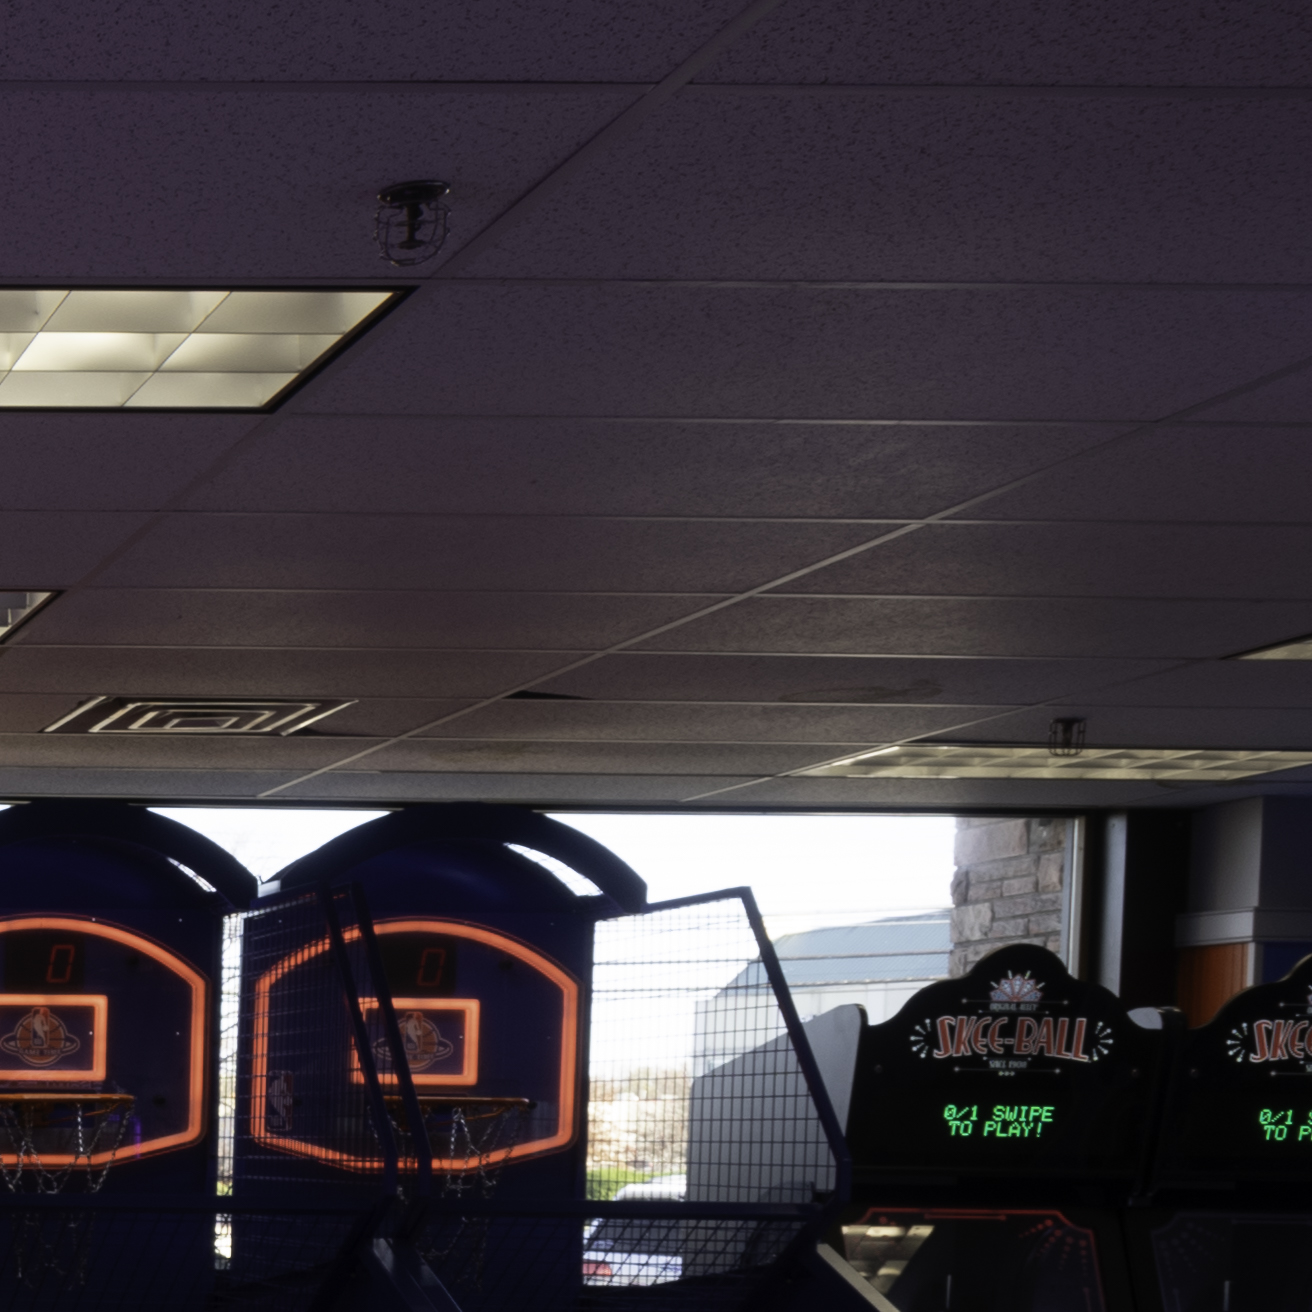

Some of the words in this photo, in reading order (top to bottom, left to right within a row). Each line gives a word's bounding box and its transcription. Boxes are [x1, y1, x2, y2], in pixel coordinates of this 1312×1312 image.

[46, 944, 75, 983] 0
[416, 949, 446, 987] 0
[933, 1015, 1092, 1062] SKEE-BALL
[993, 1105, 1055, 1122] SWIPE
[948, 1121, 972, 1137] TO
[983, 1121, 1042, 1138] PLAY!
[1263, 1125, 1288, 1141] TO
